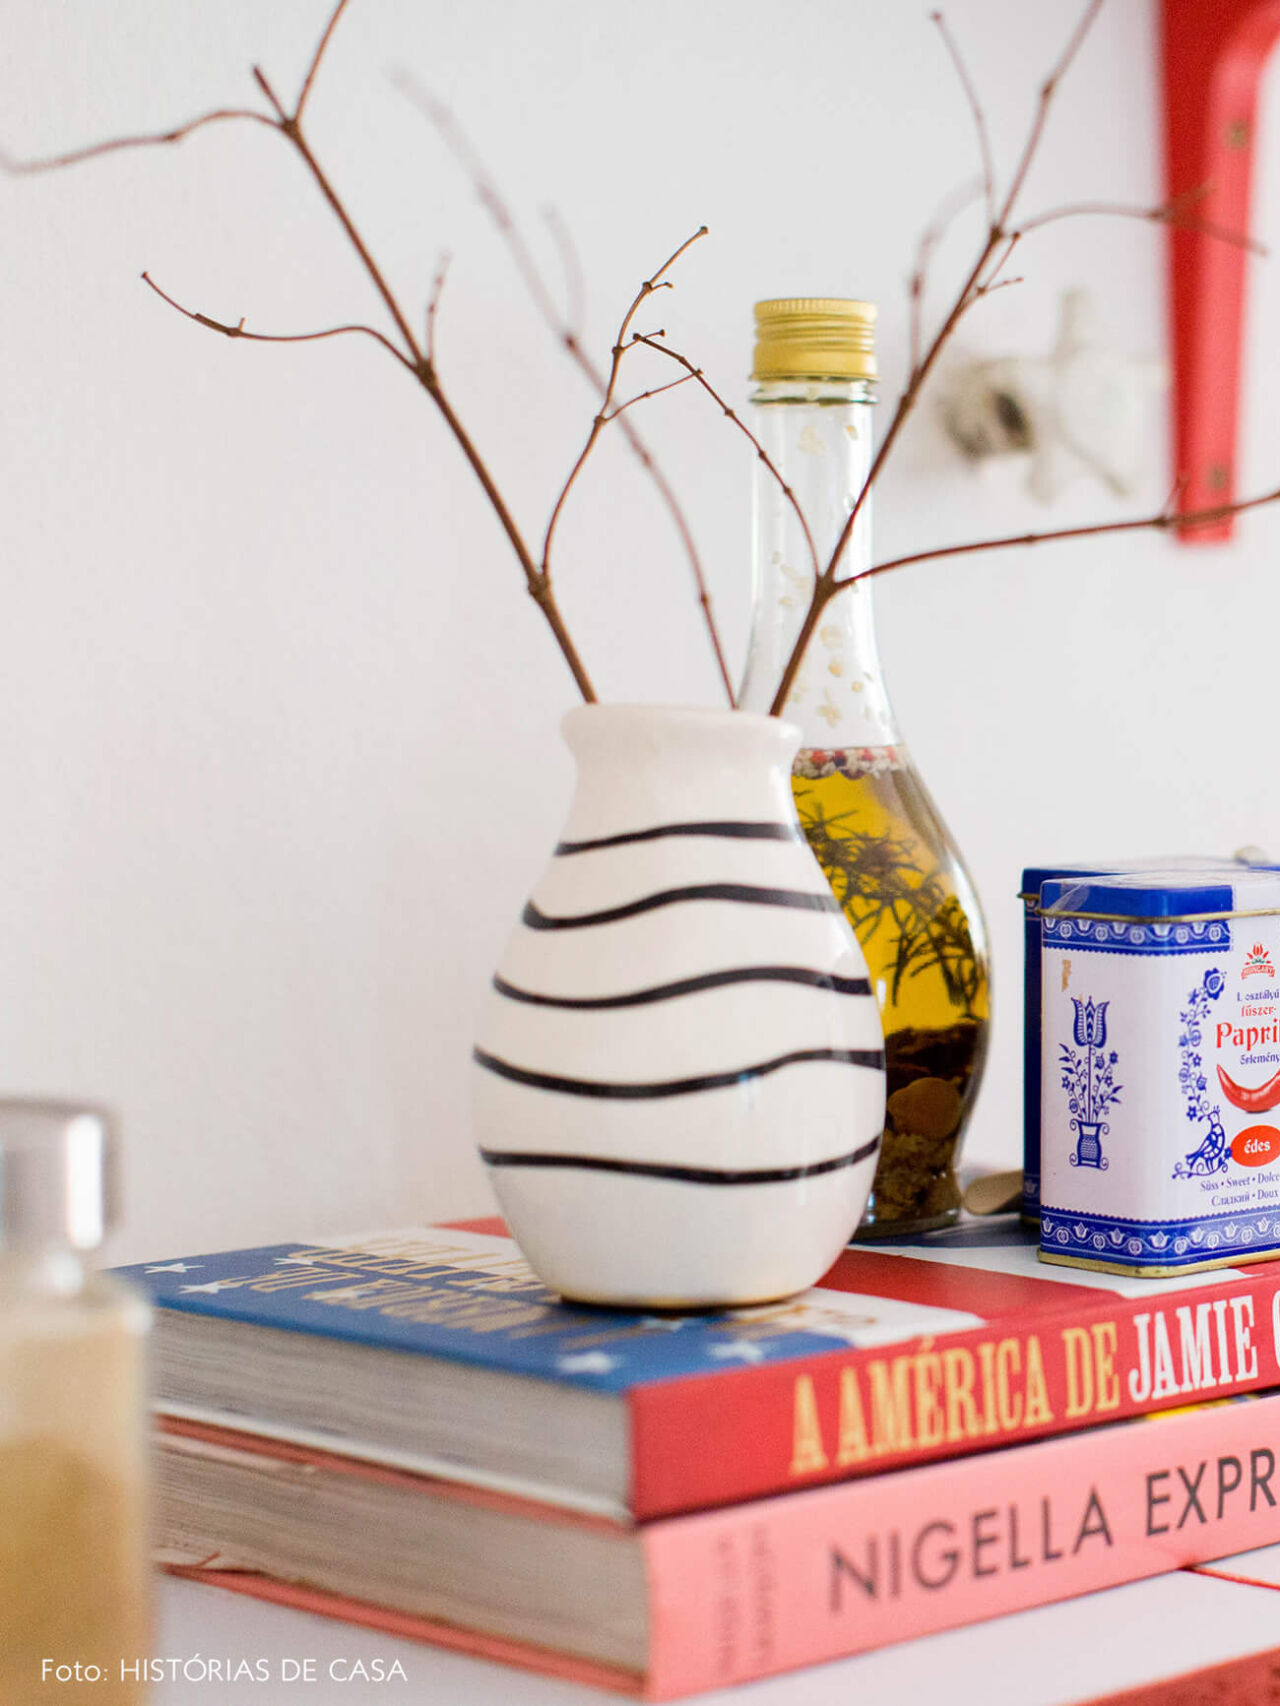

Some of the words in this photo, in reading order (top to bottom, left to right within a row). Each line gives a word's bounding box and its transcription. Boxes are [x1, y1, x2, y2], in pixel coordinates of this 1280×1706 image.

[1243, 1138, 1271, 1154] édes
[1226, 1176, 1250, 1188] Sweet
[1257, 1172, 1280, 1184] Dolce
[1257, 1189, 1279, 1200] Doux
[789, 1373, 829, 1476] A
[835, 1335, 1054, 1468] AMÉRICA
[1062, 1321, 1121, 1418] DE
[1128, 1295, 1259, 1403] JAMIE
[829, 1482, 1114, 1617] NIGELLA
